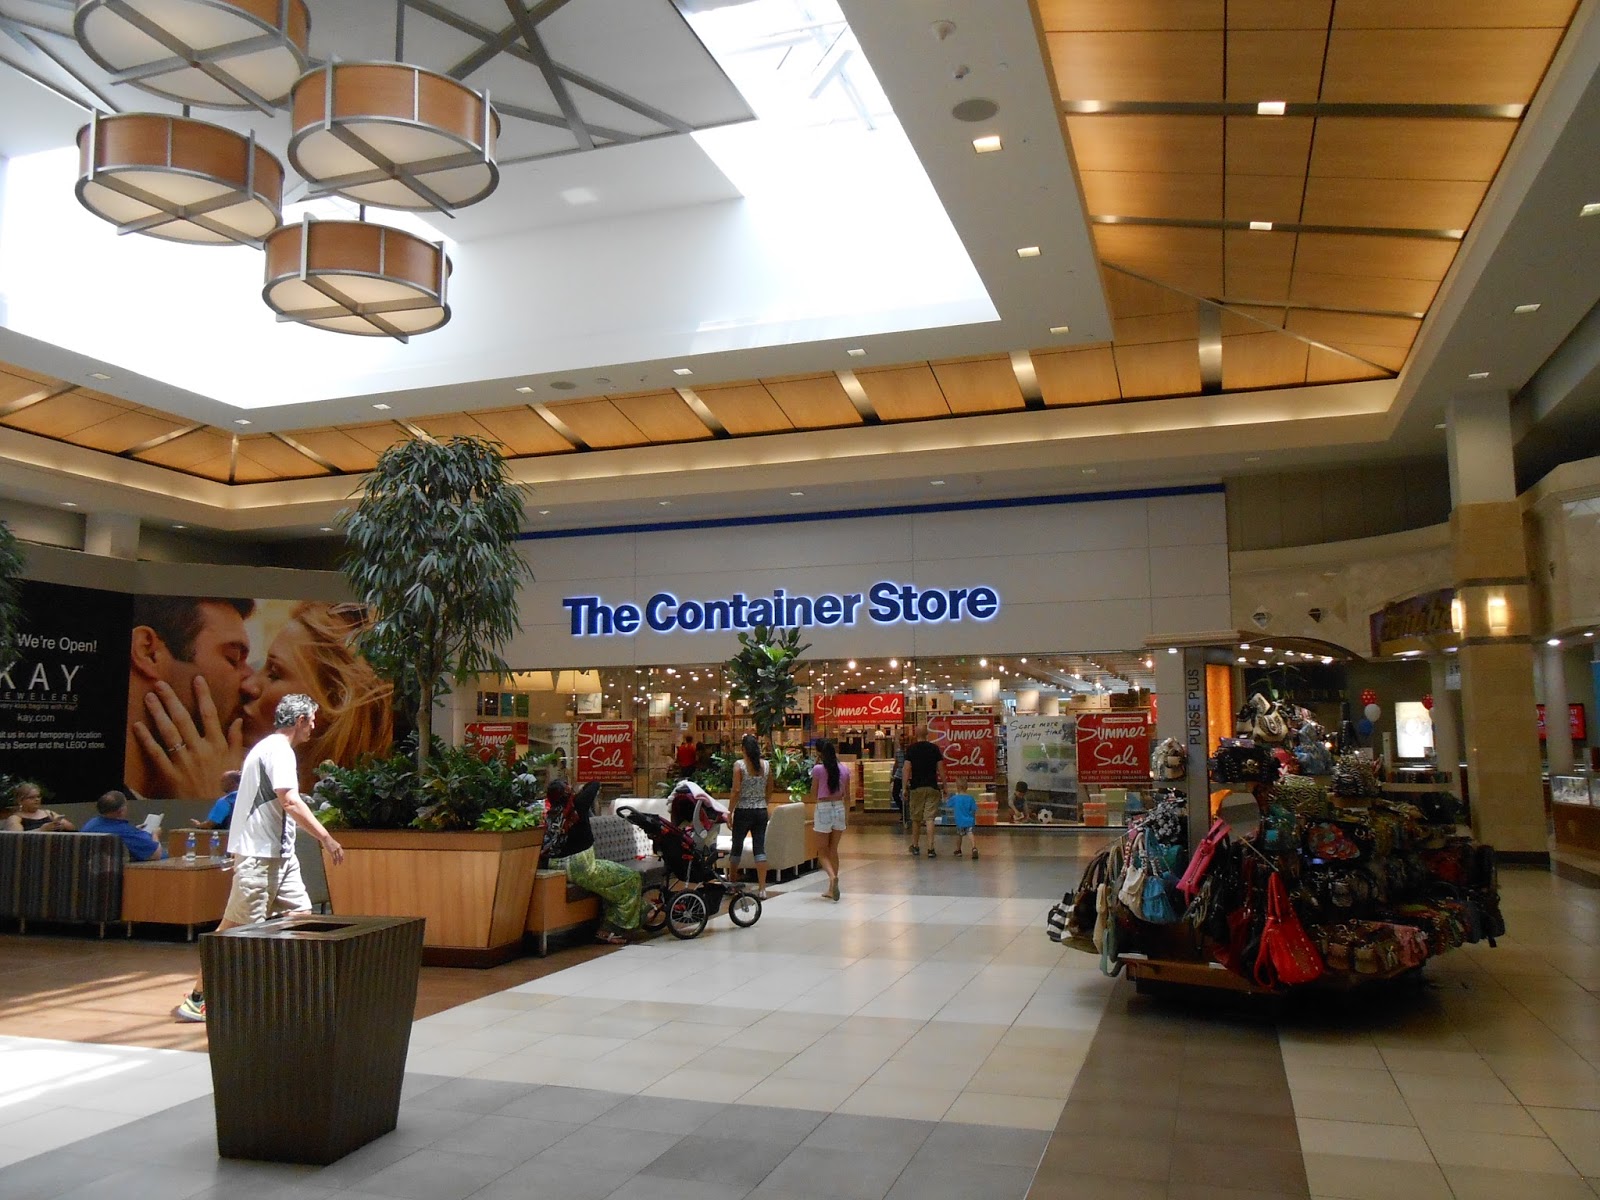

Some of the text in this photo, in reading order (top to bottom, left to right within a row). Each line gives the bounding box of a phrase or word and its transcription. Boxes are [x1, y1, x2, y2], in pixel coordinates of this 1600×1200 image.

[562, 582, 999, 636] The Container Store
[17, 633, 98, 654] We're Open!
[4, 691, 79, 702] EWELERS
[816, 695, 902, 719] Summer Sale
[1187, 669, 1201, 745] PURSE PLUS
[17, 713, 55, 724] kay.com
[926, 716, 993, 743] Summer
[1009, 720, 1036, 731] Score
[1077, 714, 1146, 742] Summer
[40, 731, 76, 740] temporary
[76, 731, 102, 739] location
[65, 741, 87, 749] LEGO
[578, 722, 631, 747] Summer
[1013, 731, 1042, 742] playing
[590, 747, 625, 768] Sale
[943, 743, 985, 767] Sale
[1093, 742, 1139, 766] Sale
